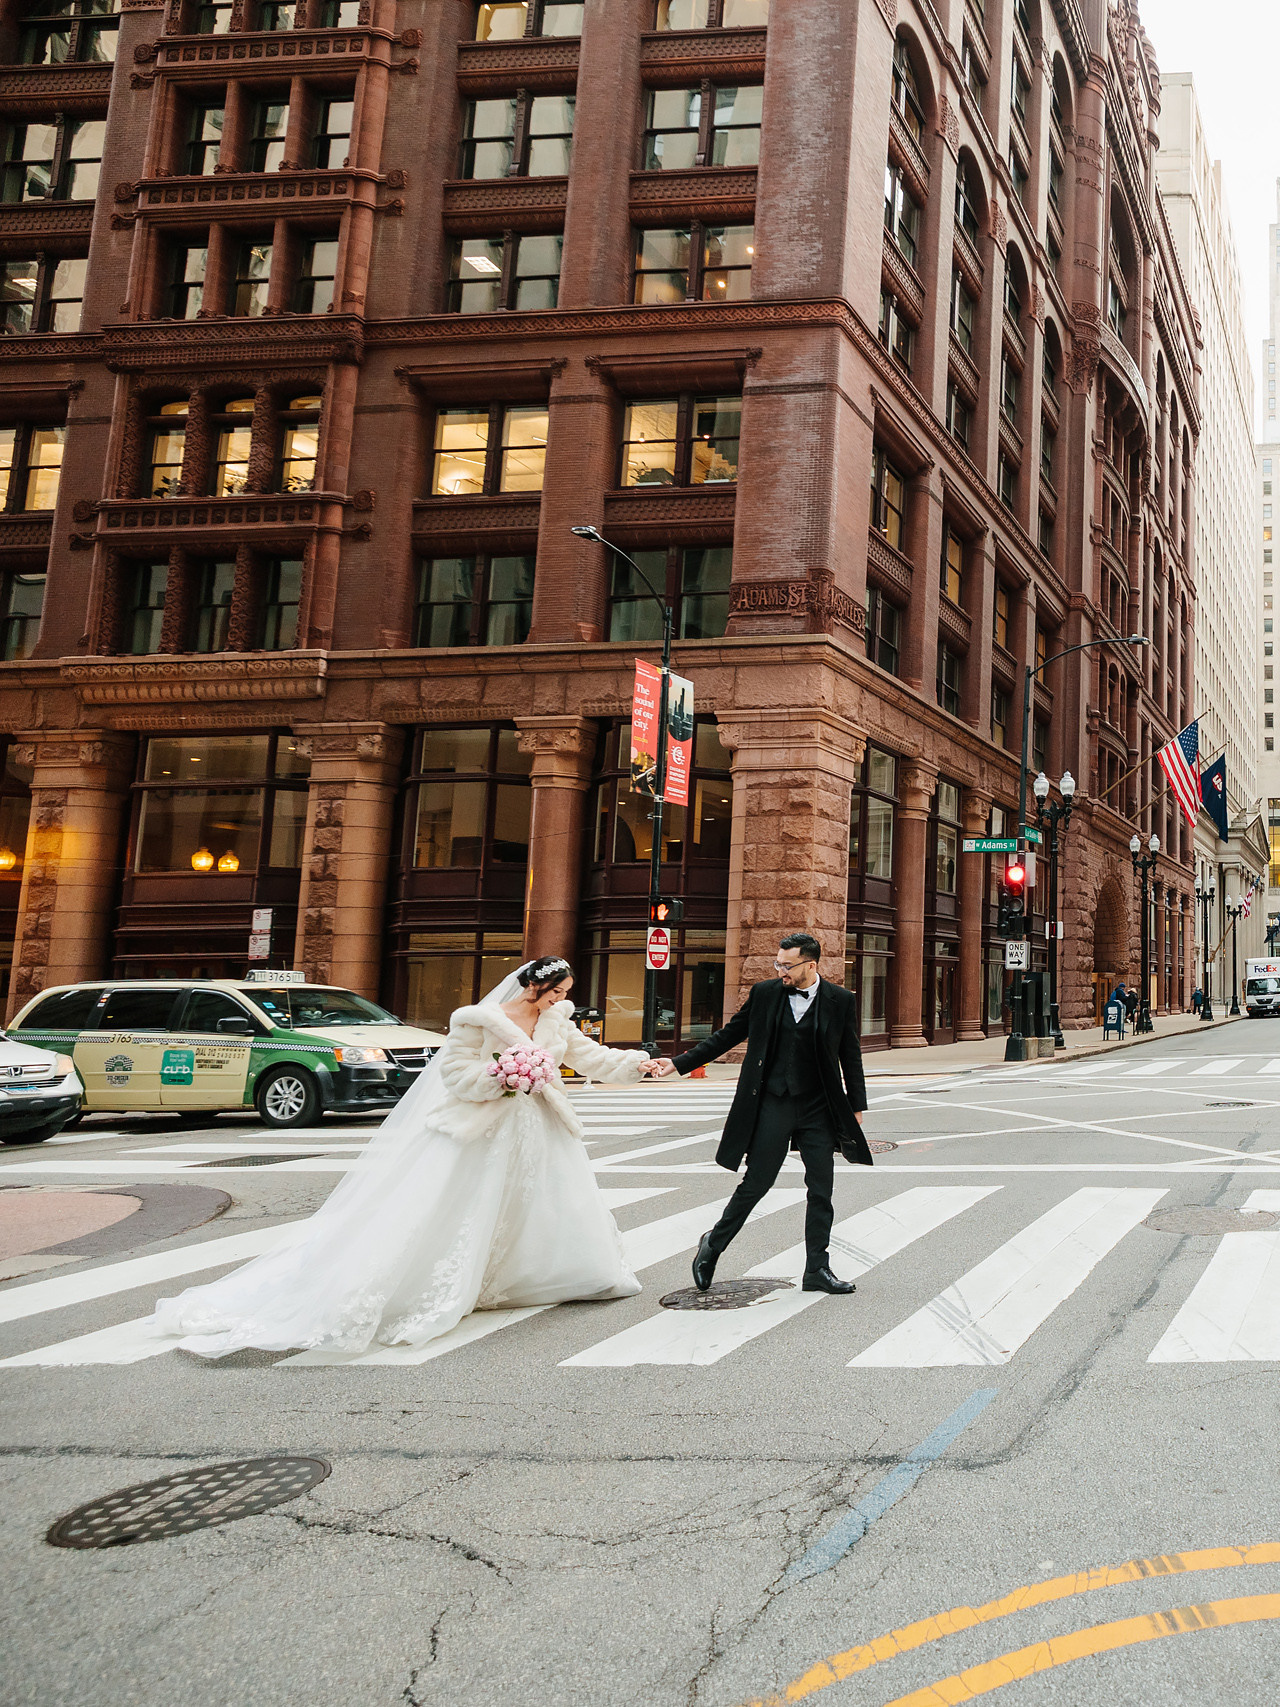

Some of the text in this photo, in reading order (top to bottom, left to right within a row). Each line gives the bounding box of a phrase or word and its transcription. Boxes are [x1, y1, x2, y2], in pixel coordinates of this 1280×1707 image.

[737, 587, 788, 609] ADAMS
[636, 683, 650, 696] The
[634, 697, 655, 709] sound
[634, 708, 654, 720] of our
[633, 719, 649, 731] city.
[981, 841, 1007, 849] Adams
[651, 935, 667, 944] DO NOT
[1008, 943, 1025, 951] ONE
[652, 953, 665, 961] ENTER
[1254, 964, 1278, 973] FedEx
[268, 972, 291, 982] 3765
[110, 1033, 133, 1043] 3765
[163, 1064, 190, 1074] curb
